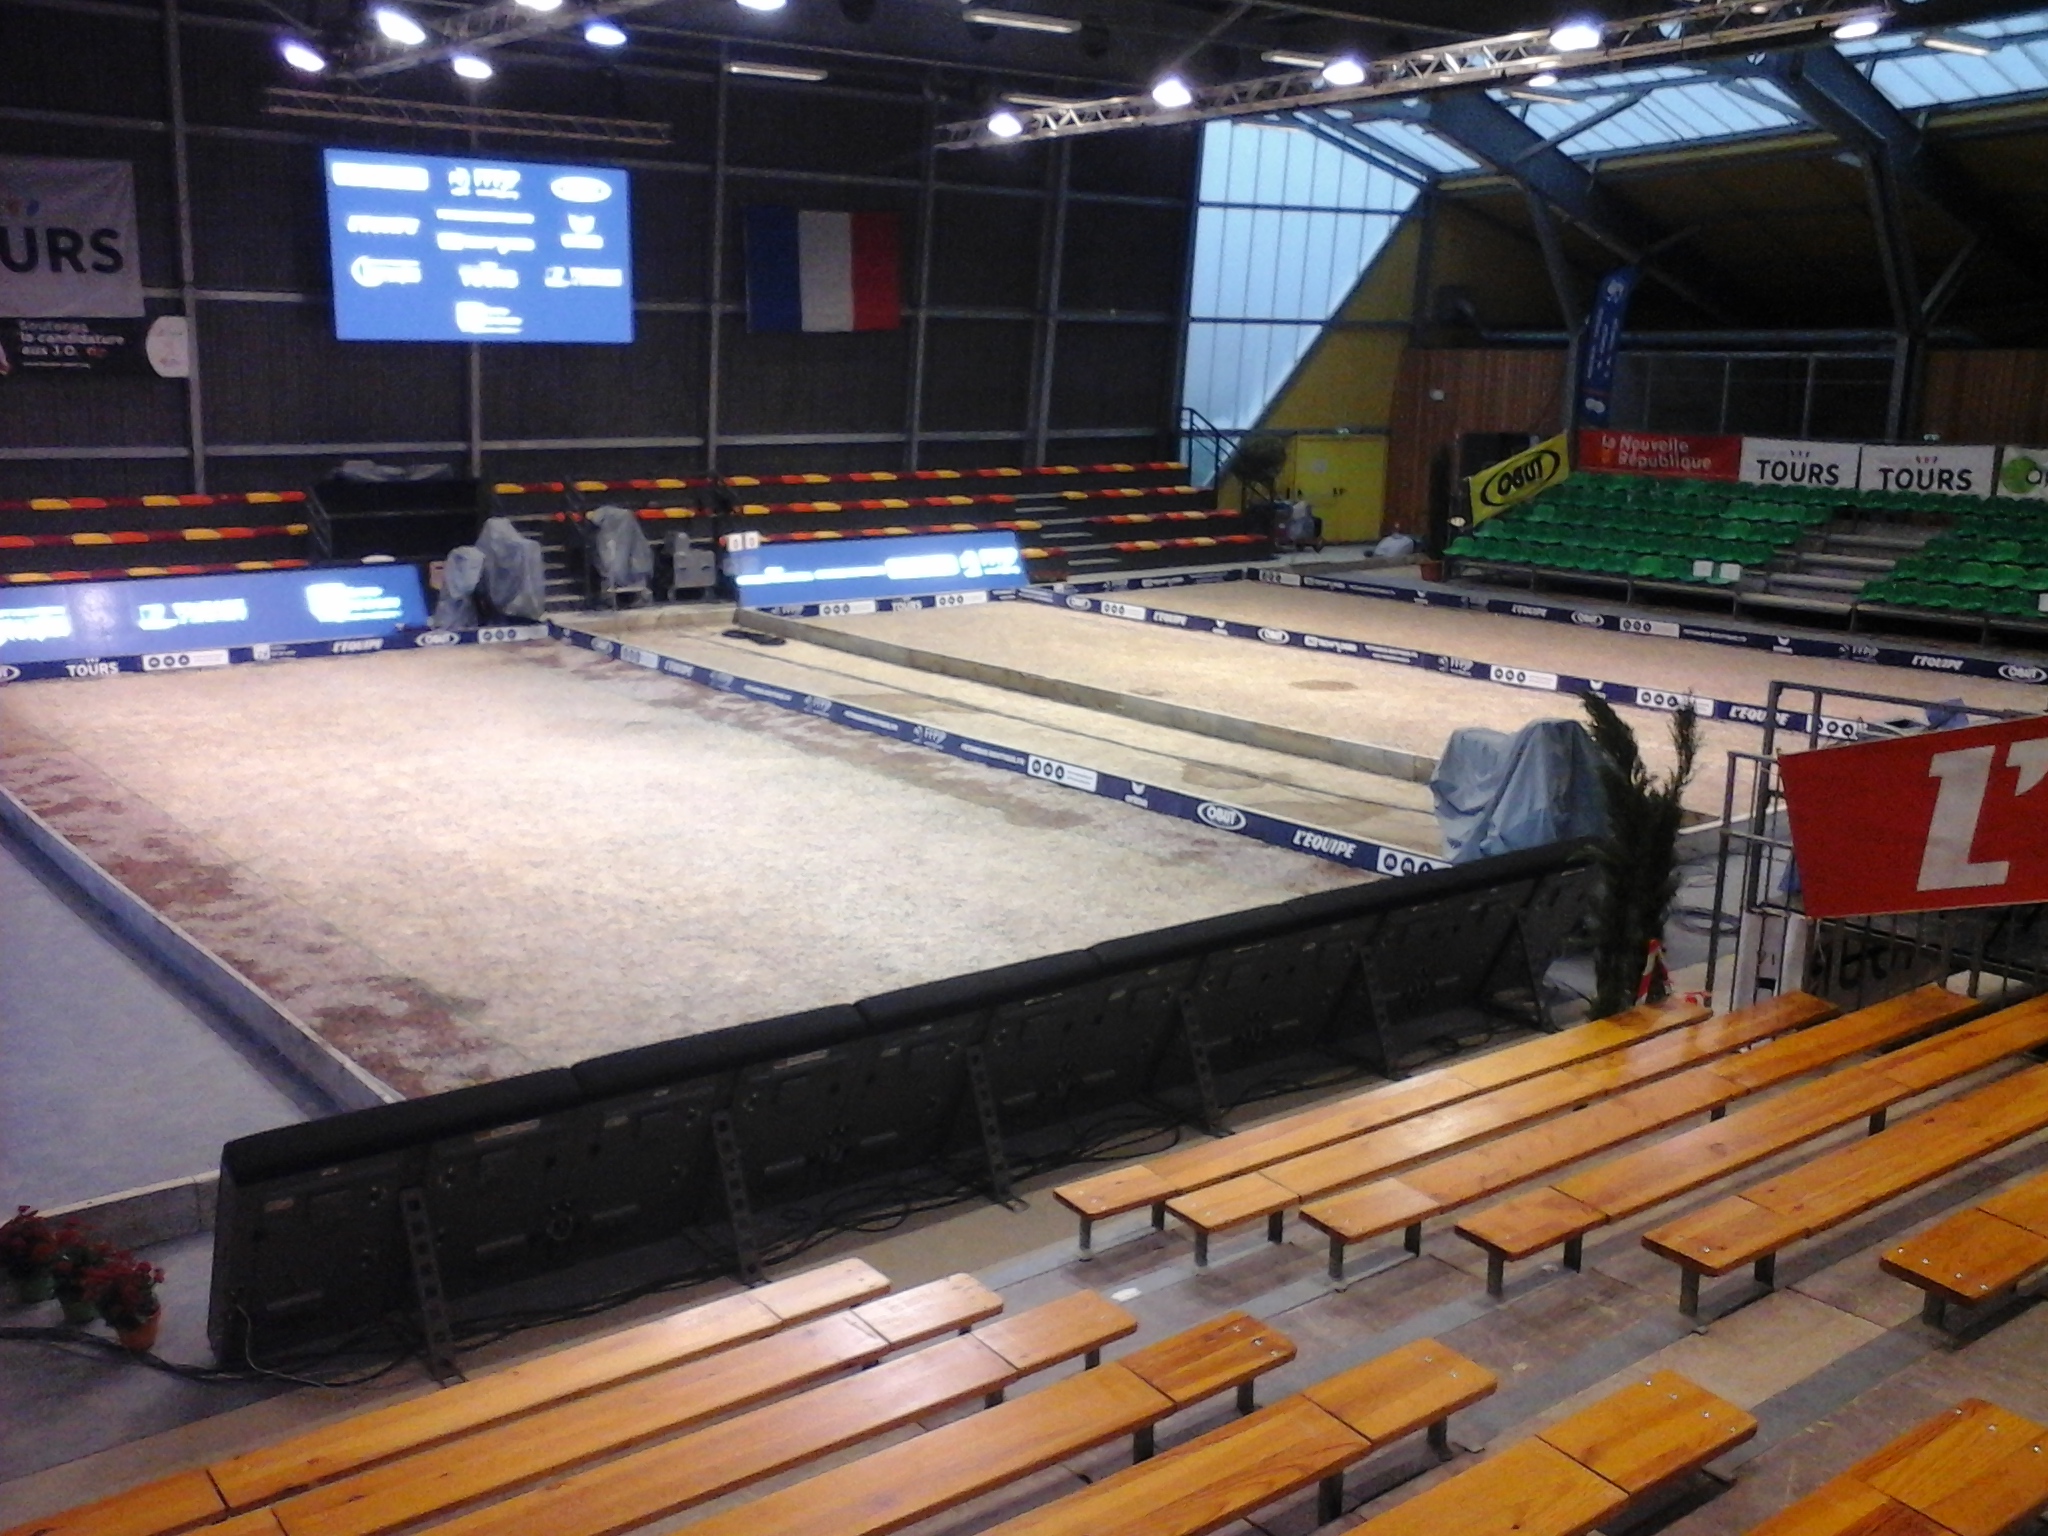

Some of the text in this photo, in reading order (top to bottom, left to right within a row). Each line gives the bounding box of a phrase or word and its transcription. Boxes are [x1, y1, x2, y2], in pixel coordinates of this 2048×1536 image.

[1619, 434, 1690, 453] Nouvelle
[1756, 458, 1840, 486] TOURS
[1879, 467, 1974, 491] TOURS
[65, 660, 119, 678] TOURS
